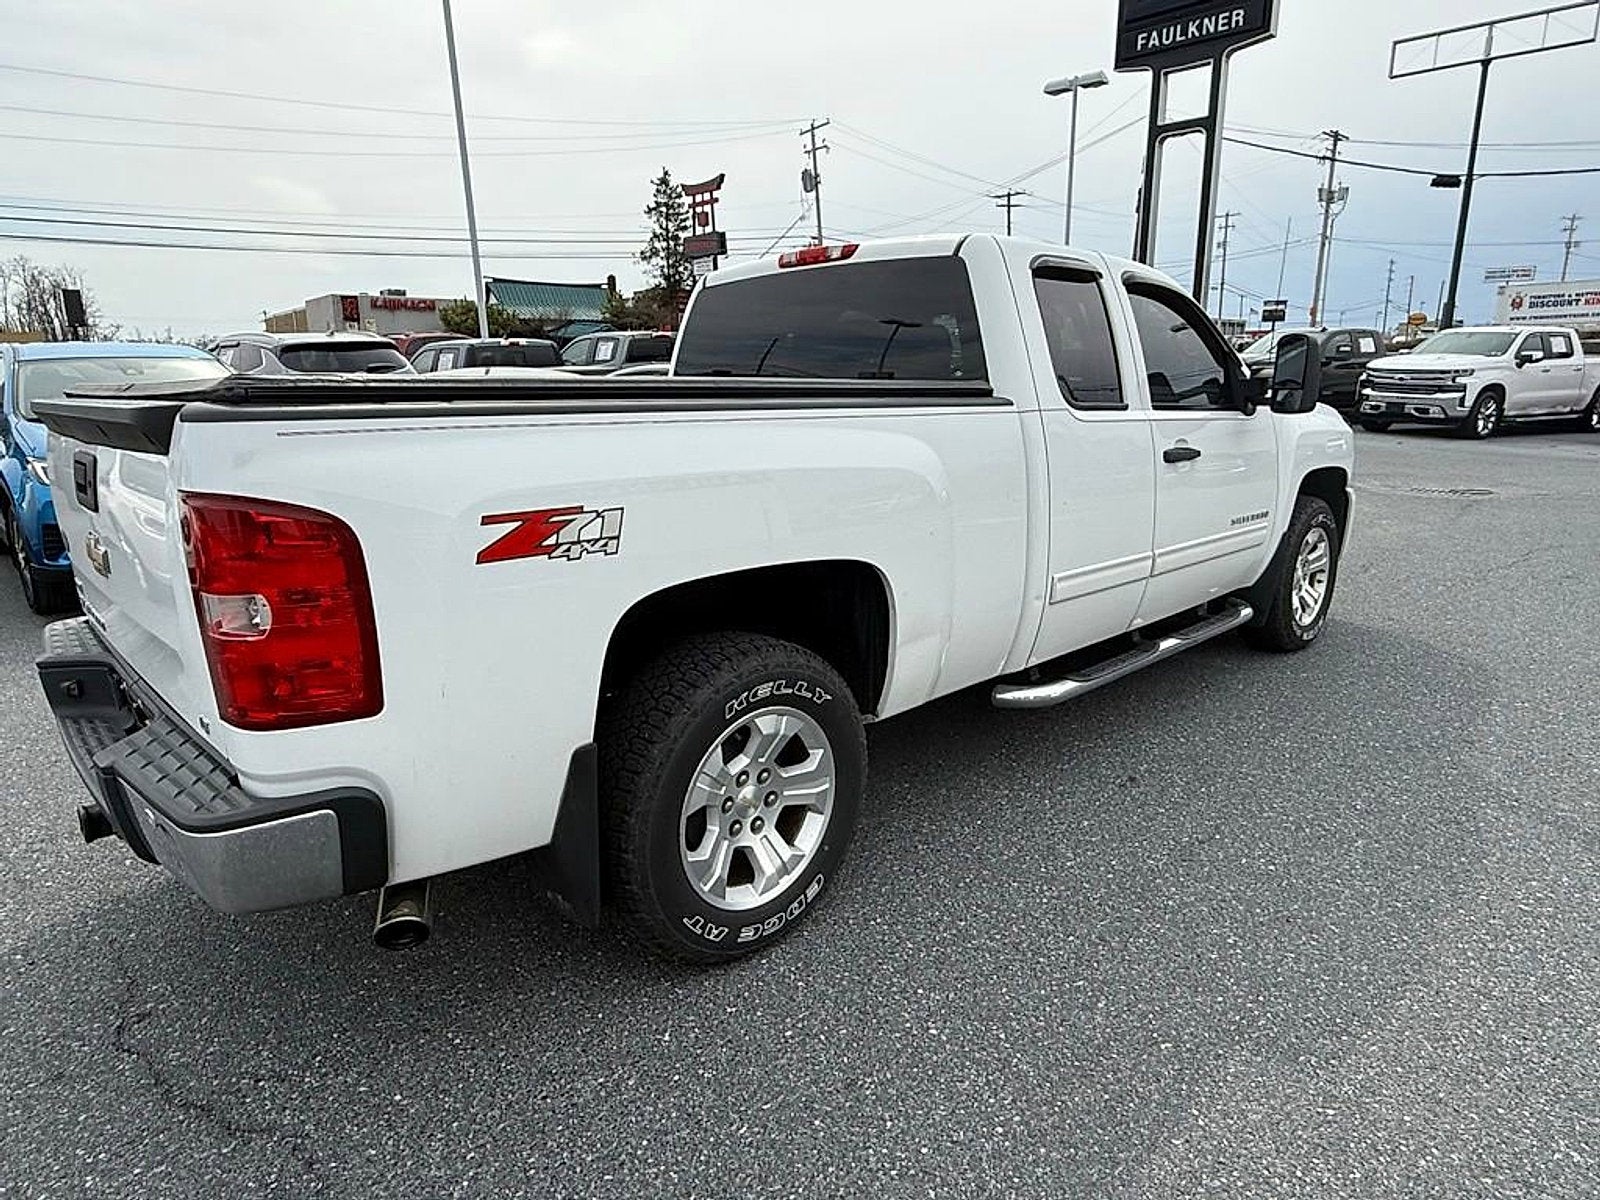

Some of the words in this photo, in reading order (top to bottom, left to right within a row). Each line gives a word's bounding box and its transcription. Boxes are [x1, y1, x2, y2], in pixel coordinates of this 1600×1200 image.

[1136, 9, 1245, 51] FAULKNER
[1528, 298, 1582, 309] DISCOUNT
[475, 505, 624, 564] Z71
[725, 679, 832, 719] KELLY
[683, 915, 729, 942] AT
[737, 873, 824, 943] EDGE
